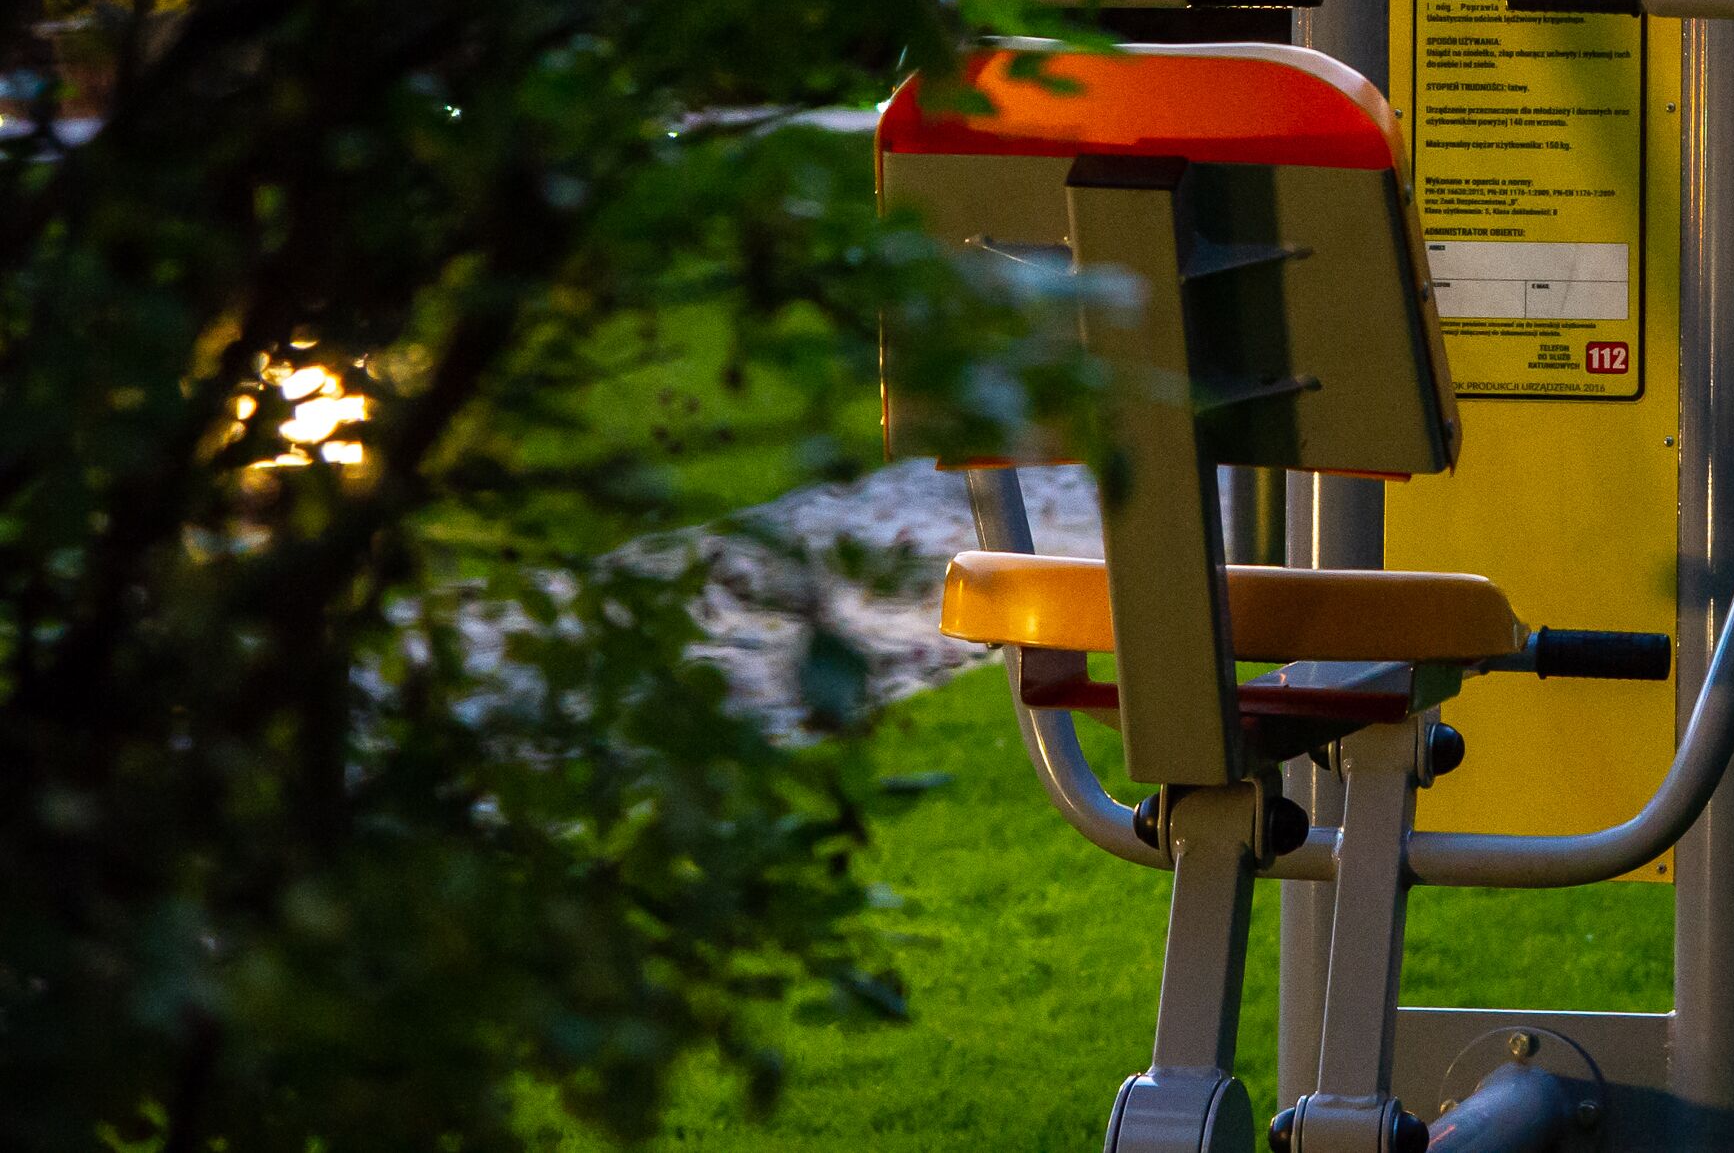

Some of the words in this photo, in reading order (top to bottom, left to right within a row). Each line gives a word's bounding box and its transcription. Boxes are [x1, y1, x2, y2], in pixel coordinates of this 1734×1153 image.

[1436, 4, 1454, 12] nóg.
[1460, 3, 1499, 12] Poprawia
[1426, 81, 1459, 91] STOPIEŃ
[1461, 82, 1506, 91] TRUDNOŚCI:
[1425, 177, 1462, 186] Wykonano
[1471, 178, 1500, 187] oparciu
[1425, 228, 1488, 236] ADMINISTRATOR
[1490, 228, 1526, 237] OBIEKTU:
[1540, 344, 1570, 352] TELEFON
[1589, 347, 1626, 369] 112
[1528, 362, 1580, 370] RATUNKOWYCH
[1467, 381, 1519, 391] PRODUKCJI
[1521, 382, 1581, 392] URZĄDZENIA
[1584, 383, 1606, 392] 2016
